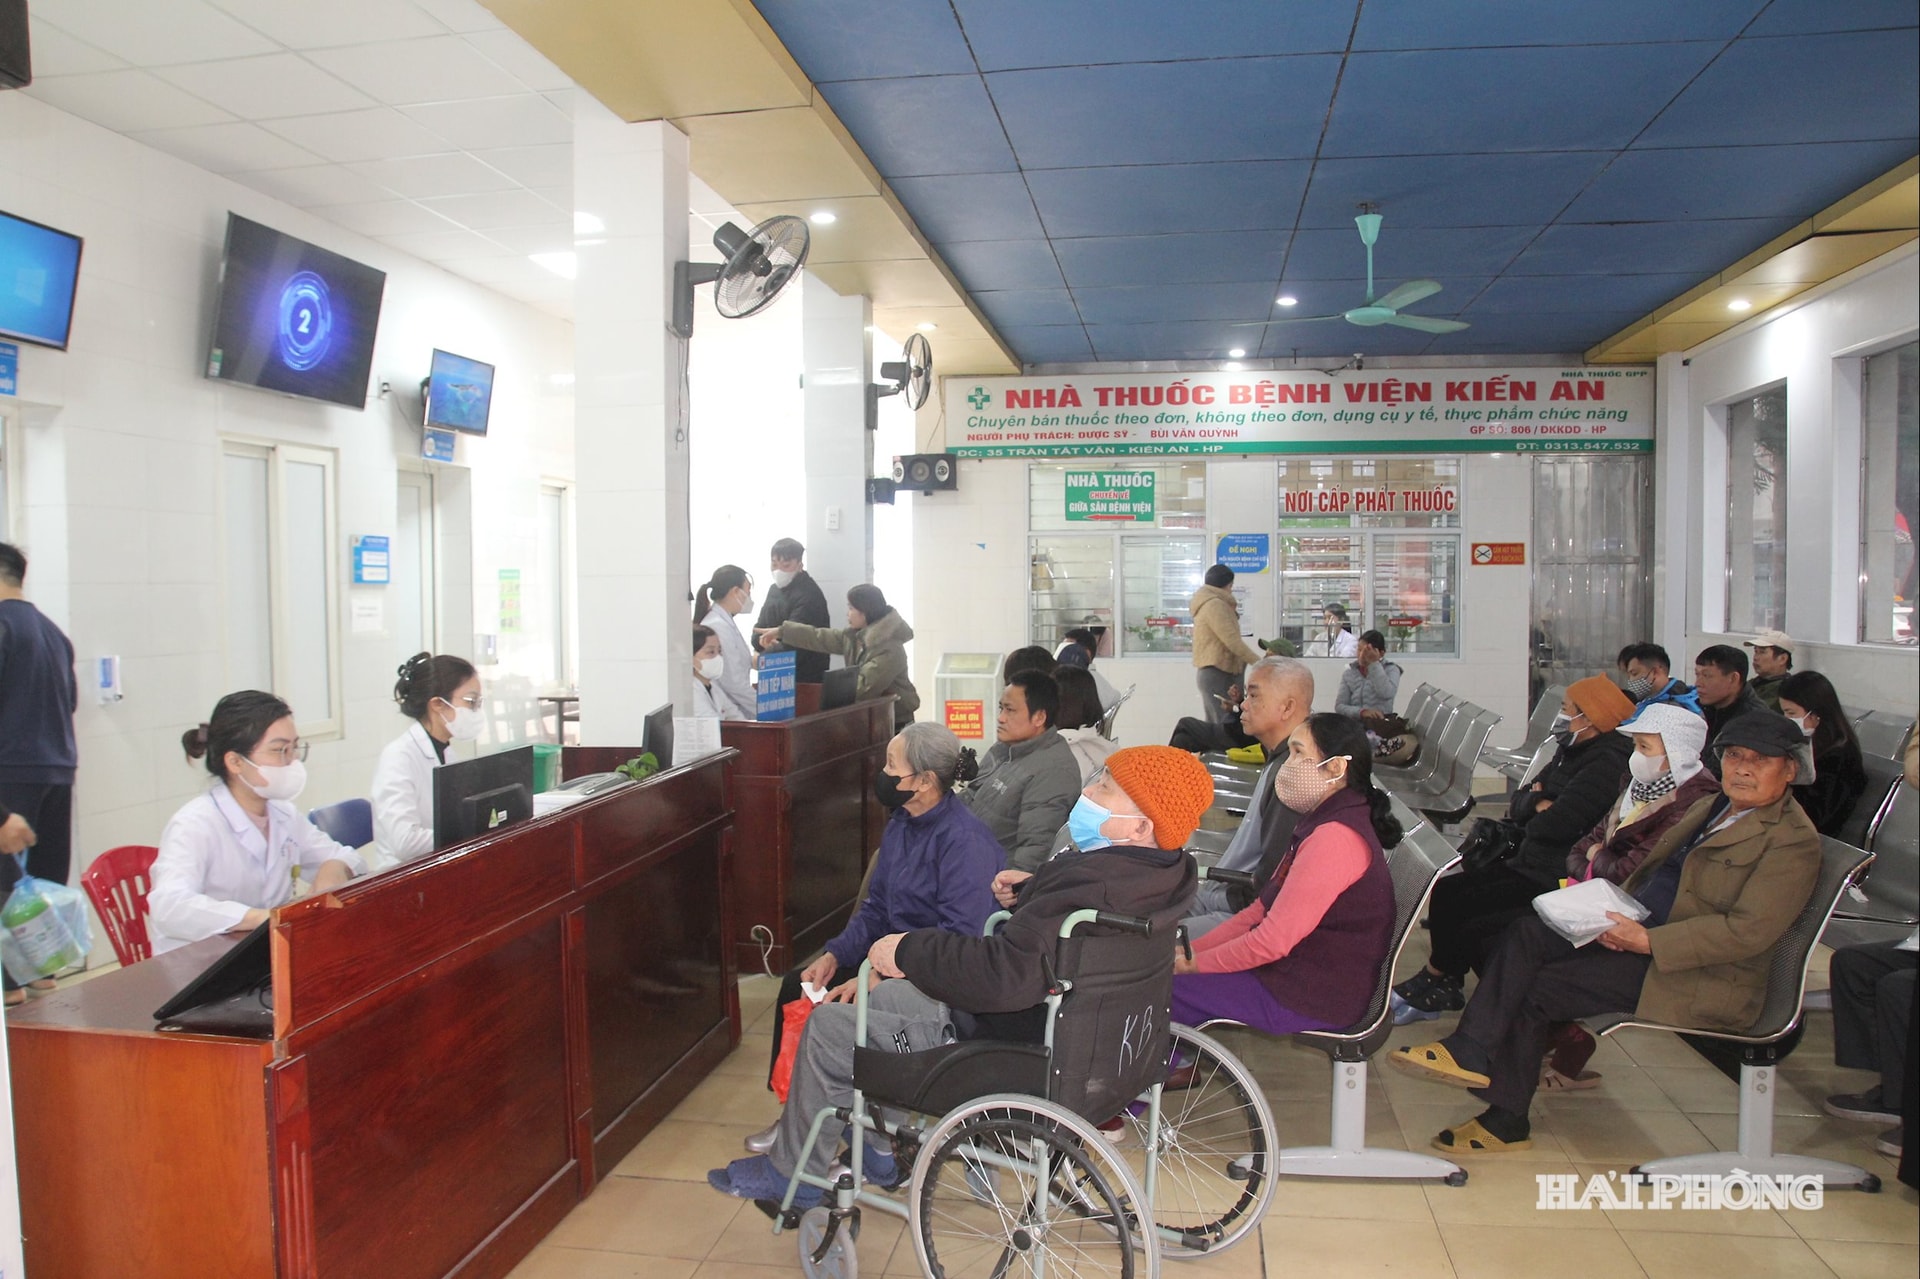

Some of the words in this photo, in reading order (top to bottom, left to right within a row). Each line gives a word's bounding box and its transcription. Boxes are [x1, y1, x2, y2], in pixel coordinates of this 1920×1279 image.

[297, 308, 312, 334] 2
[1561, 370, 1584, 378] NHÀ
[1588, 370, 1622, 378] THUỐC
[1005, 384, 1082, 409] NHÀ
[1093, 379, 1215, 407] THUỐC
[1229, 380, 1331, 408] BỆNH
[1343, 378, 1431, 407] VIỆN
[1445, 374, 1536, 401] KIẾN
[1549, 380, 1605, 401] AN
[967, 415, 1026, 430] Chuyên
[1031, 415, 1059, 426] bán
[1065, 410, 1109, 426] thuốc
[1114, 412, 1149, 425] theo
[1154, 412, 1189, 425] đơn,
[1195, 411, 1246, 429] không
[1251, 411, 1286, 422] theo
[1291, 410, 1327, 423] đơn,
[1333, 409, 1374, 424] dụng
[1380, 412, 1399, 423] cụ
[1404, 411, 1415, 424] y
[1419, 405, 1438, 422] tế,
[1445, 408, 1482, 422] thực
[1487, 405, 1533, 422] phẩm
[1539, 407, 1581, 420] chức
[1586, 408, 1628, 422] năng
[967, 432, 1002, 441] NGƯỜI
[1007, 432, 1030, 441] PHỤ
[1034, 432, 1074, 440] TRÁCH:
[1114, 428, 1128, 438] SỸ
[1150, 428, 1168, 438] BÙI
[1172, 428, 1196, 438] VĂN
[1199, 427, 1239, 438] QUỲNH
[1470, 426, 1485, 434] GP
[1511, 426, 1531, 434] 806
[1592, 425, 1607, 434] HP
[987, 449, 1003, 457] 35
[1081, 447, 1115, 455] VĂN
[1129, 445, 1162, 454] KIẾN
[1203, 445, 1224, 453] HP
[1516, 442, 1540, 450] ĐT:
[1544, 442, 1640, 450] 0313.547.532
[1067, 472, 1099, 487] NHÀ
[1103, 470, 1152, 487] THUỐC
[1089, 488, 1118, 499] CHUYỂN
[1120, 488, 1130, 499] VỀ
[1285, 490, 1313, 513] NƠI
[1318, 484, 1350, 513] CẤP
[1355, 487, 1397, 512] PHÁT
[1402, 482, 1454, 512] THUỐC
[1069, 502, 1088, 512] GIỮA
[1090, 501, 1107, 512] SÂN
[1109, 502, 1131, 514] BỆNH
[1132, 502, 1152, 514] VIỆN
[1228, 544, 1239, 554] ĐỀ
[1240, 546, 1257, 555] NGHỊ
[769, 672, 780, 693] TIẾP
[950, 711, 967, 721] CẢM
